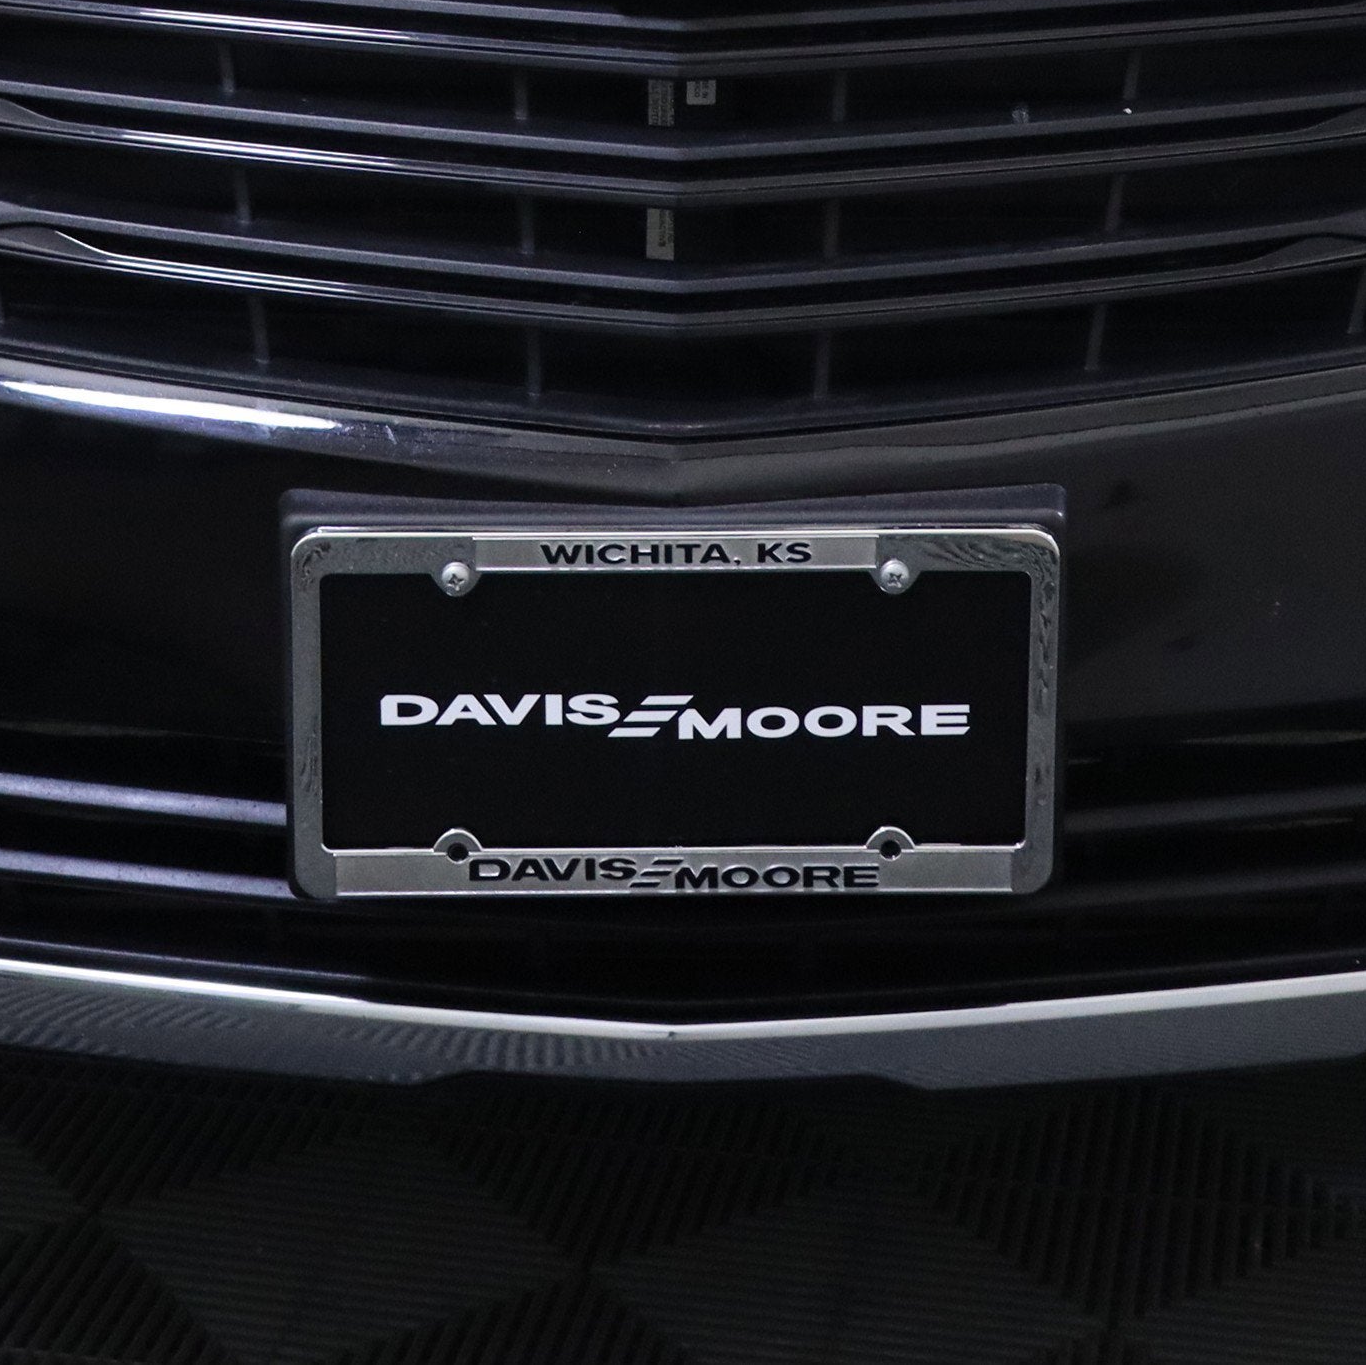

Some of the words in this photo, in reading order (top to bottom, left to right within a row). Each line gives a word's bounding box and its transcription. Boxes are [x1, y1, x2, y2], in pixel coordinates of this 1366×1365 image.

[757, 542, 812, 564] KS
[380, 694, 620, 727] DAVIS
[678, 703, 971, 740] MOORE
[468, 857, 636, 882] DAVIS
[673, 865, 880, 890] MOORE
